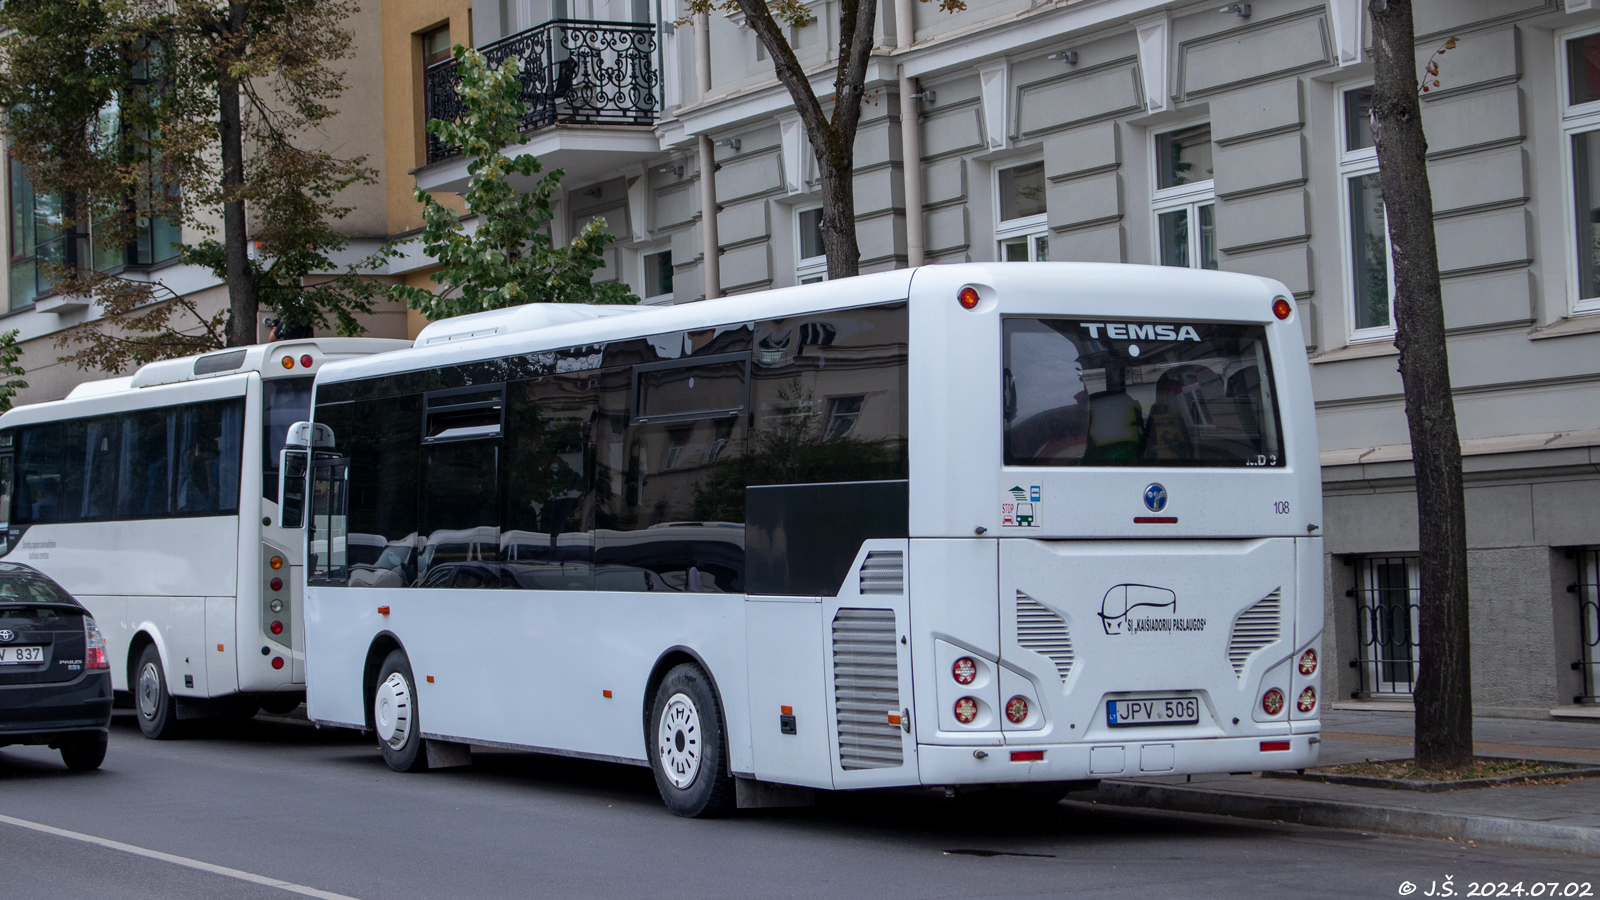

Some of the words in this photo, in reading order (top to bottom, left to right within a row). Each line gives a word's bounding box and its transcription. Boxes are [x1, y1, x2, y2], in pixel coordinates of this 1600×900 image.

[1080, 322, 1202, 342] TEMSA
[1002, 503, 1014, 514] STOP
[1273, 500, 1290, 515] 108
[16, 648, 40, 661] 837
[1119, 702, 1154, 720] JPV
[1165, 700, 1195, 718] 506
